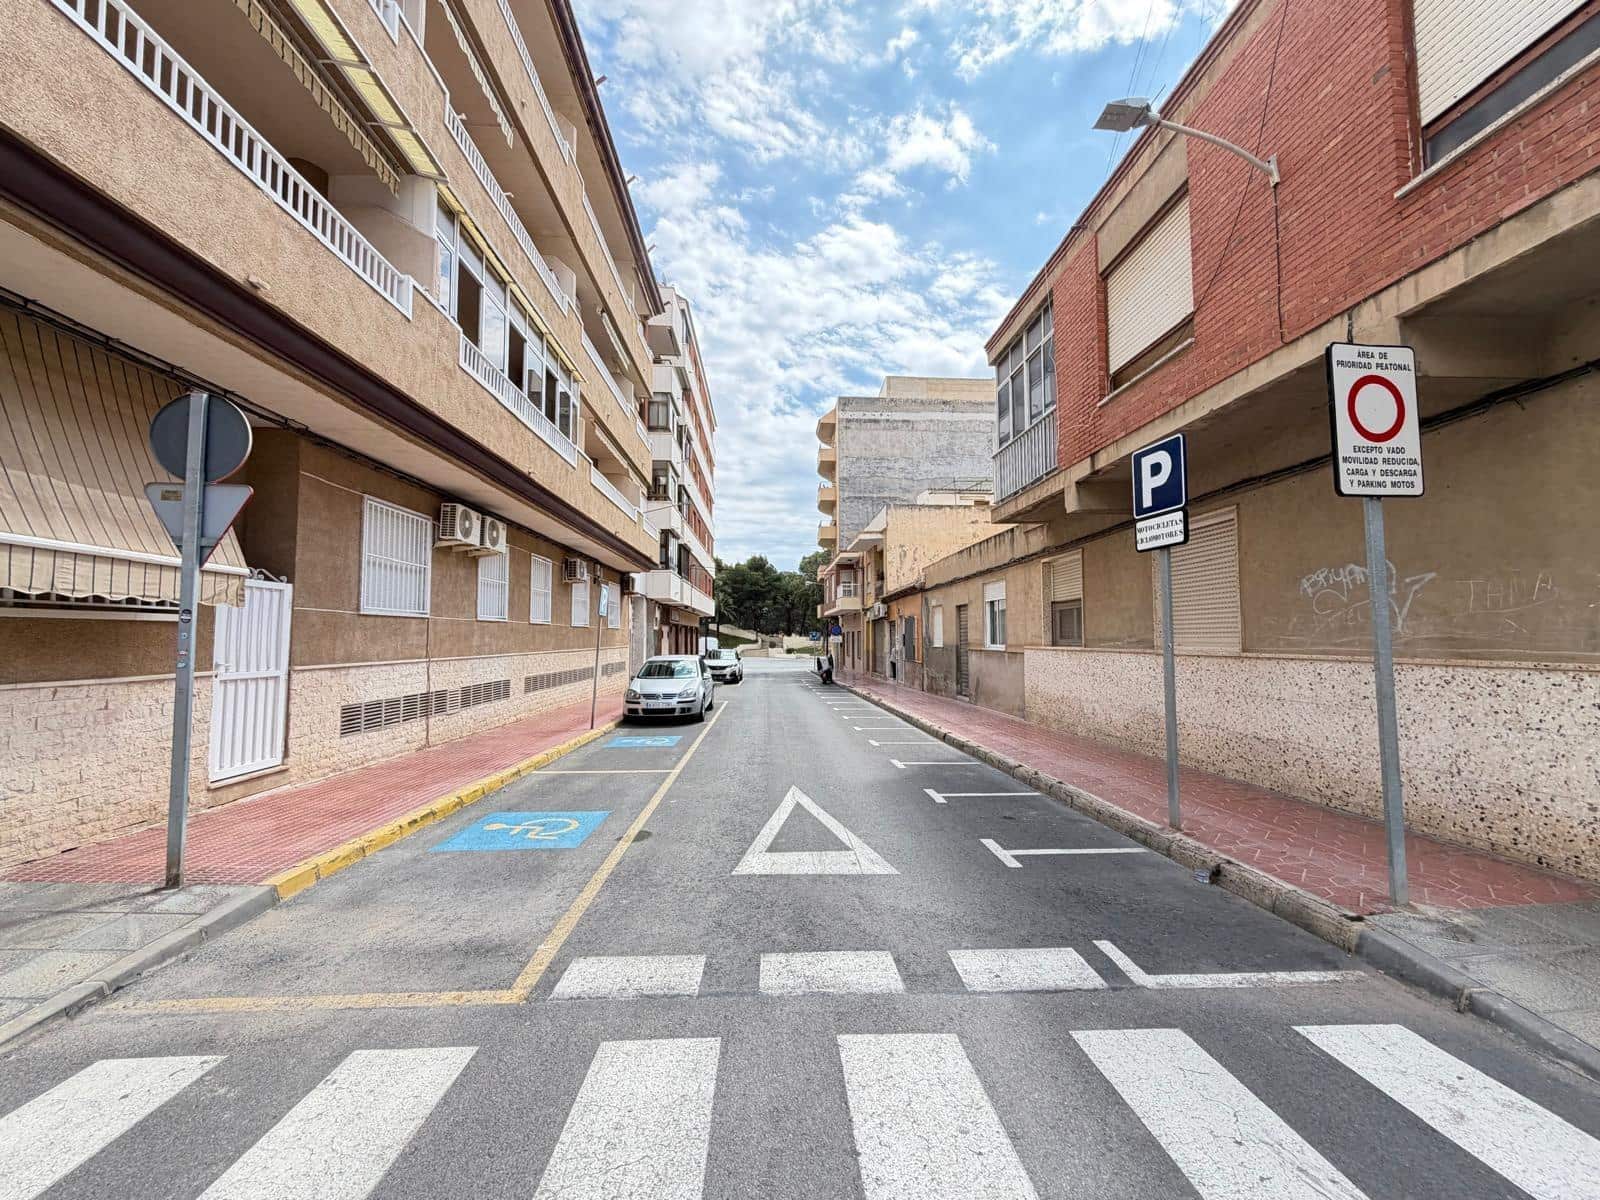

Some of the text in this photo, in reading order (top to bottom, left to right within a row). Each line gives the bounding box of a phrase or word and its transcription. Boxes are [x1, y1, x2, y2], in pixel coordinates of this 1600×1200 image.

[1356, 349, 1388, 360] ÁREA DE
[1336, 360, 1411, 371] PRIORIDAD PEATONAL
[1352, 445, 1406, 454] EXCEPTO VADO
[1342, 456, 1378, 465] MOVILIDAD
[1345, 468, 1369, 476] CARGA
[1379, 469, 1417, 477] DESCARGA
[1142, 451, 1172, 508] P
[1348, 479, 1415, 489] Y PARKING MOTOS
